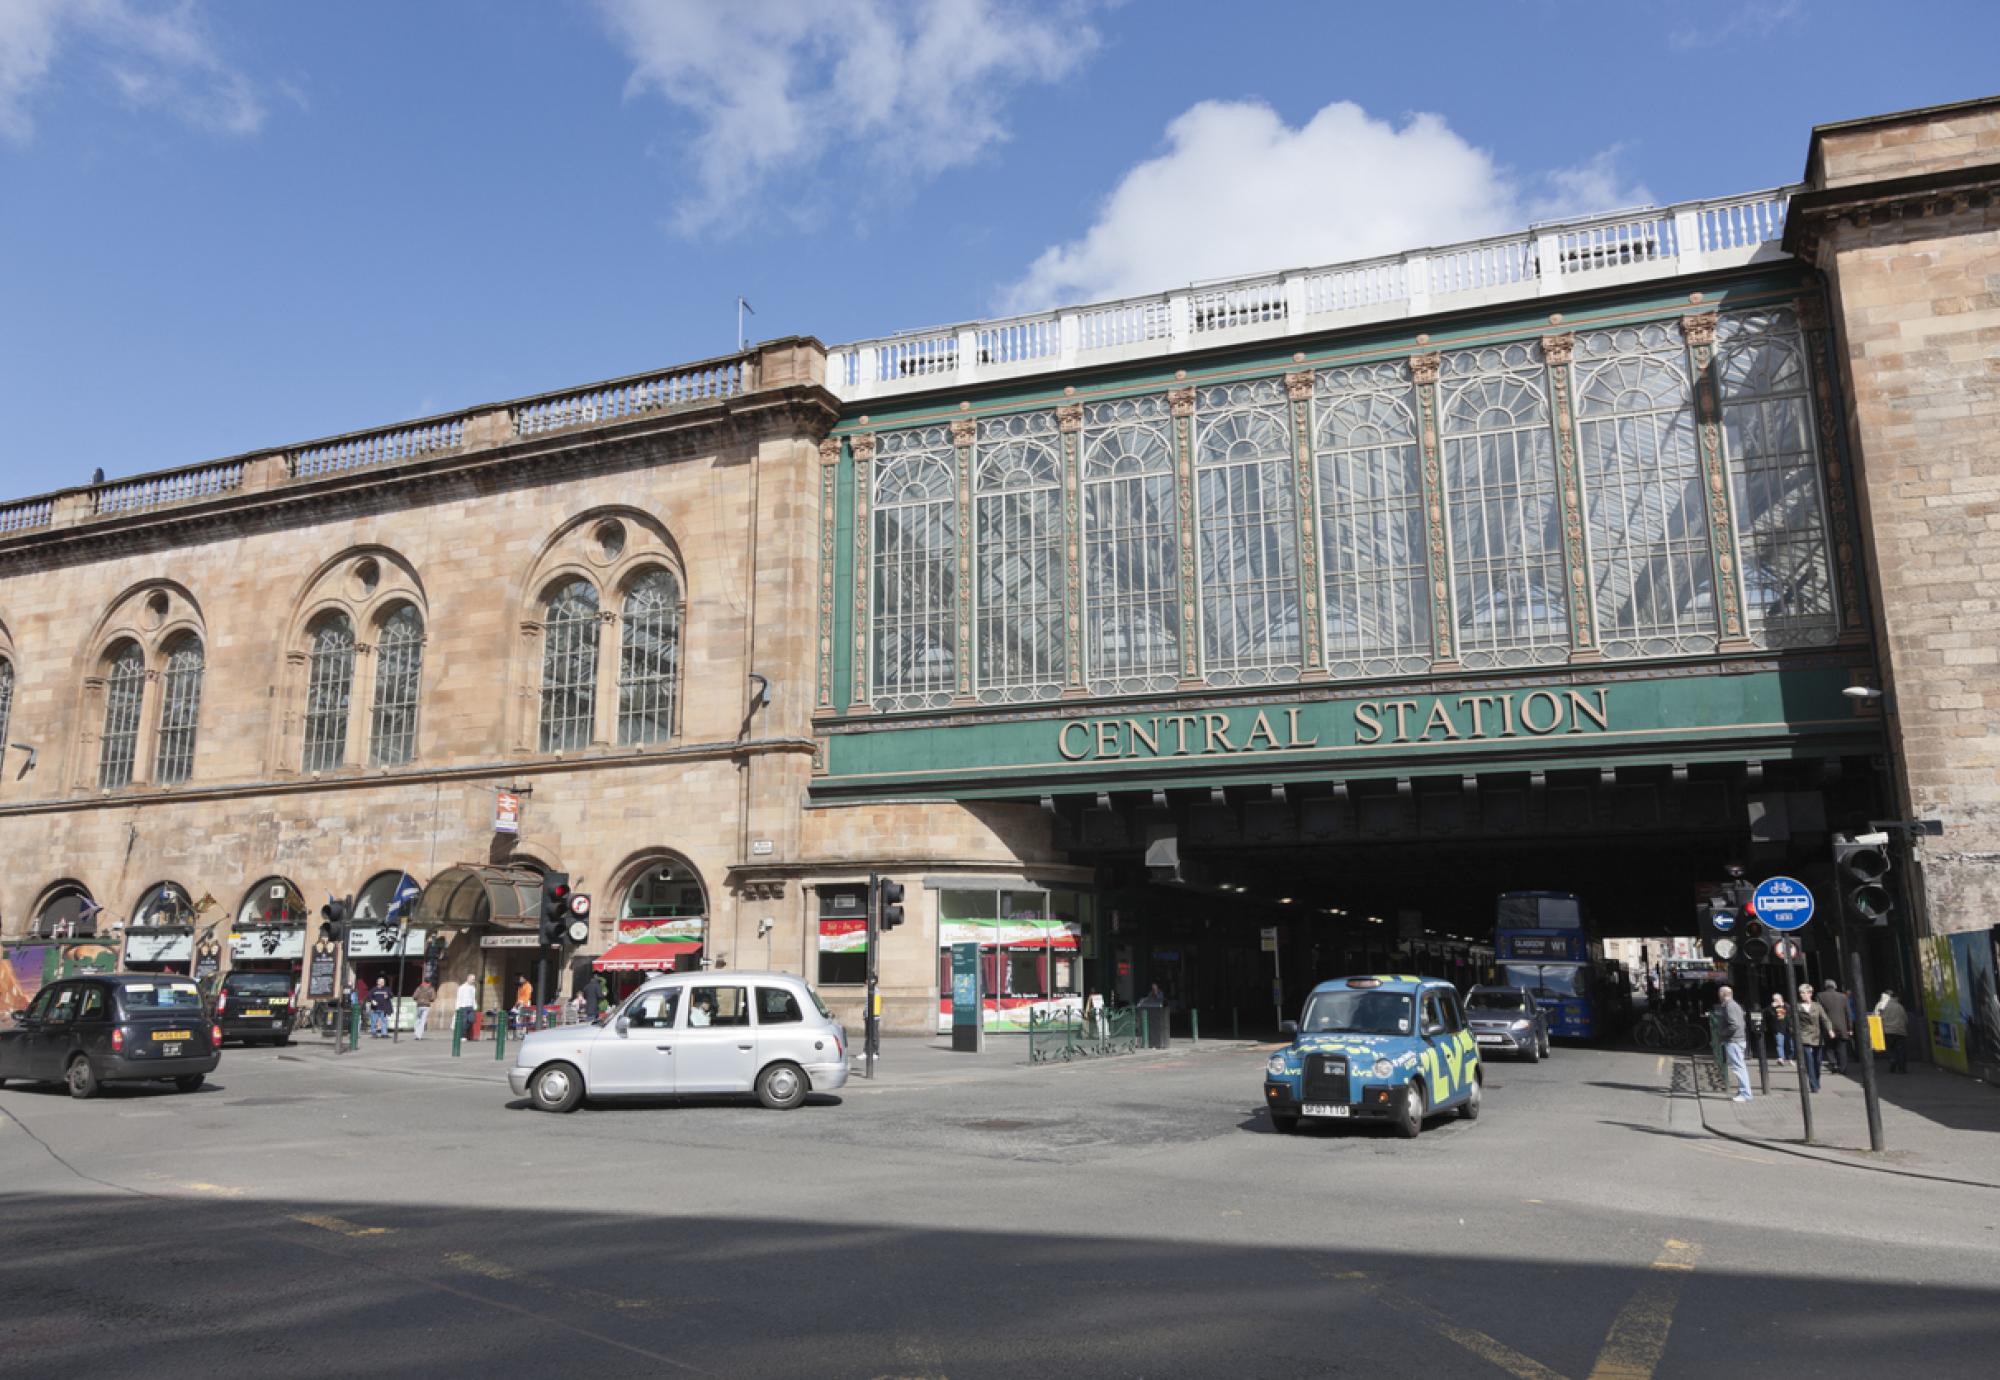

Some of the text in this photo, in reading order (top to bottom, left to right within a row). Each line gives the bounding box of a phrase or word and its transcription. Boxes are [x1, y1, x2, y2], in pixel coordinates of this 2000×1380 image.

[1058, 687, 1609, 761] CENTRAL STATION
[1550, 940, 1567, 952] W1
